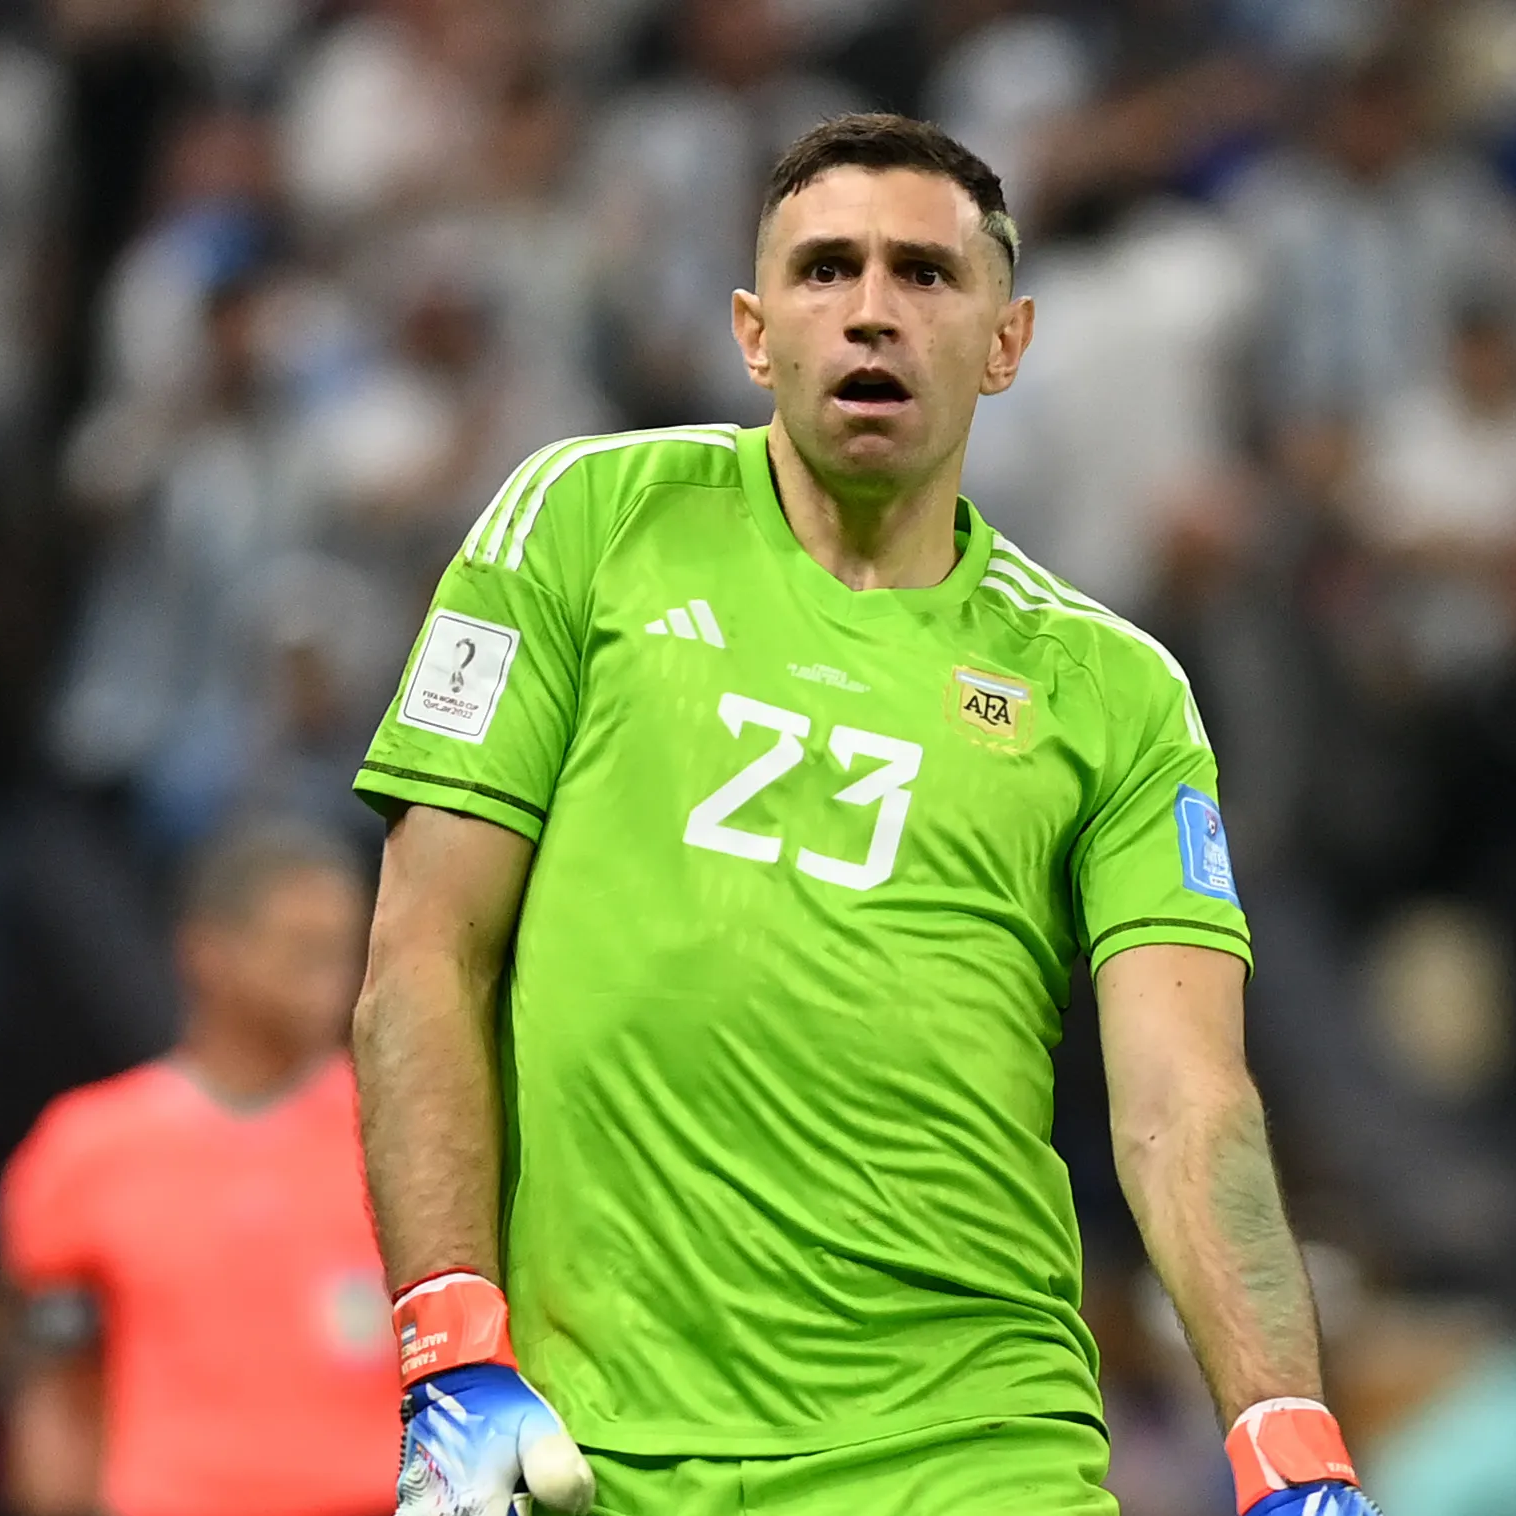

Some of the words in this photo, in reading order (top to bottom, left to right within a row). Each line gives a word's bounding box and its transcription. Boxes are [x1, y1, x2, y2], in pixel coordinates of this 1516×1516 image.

[422, 690, 438, 701] FIFA
[439, 695, 465, 707] WORLD
[465, 702, 479, 711] CUP
[963, 687, 1011, 726] AFA
[682, 691, 924, 892] 23
